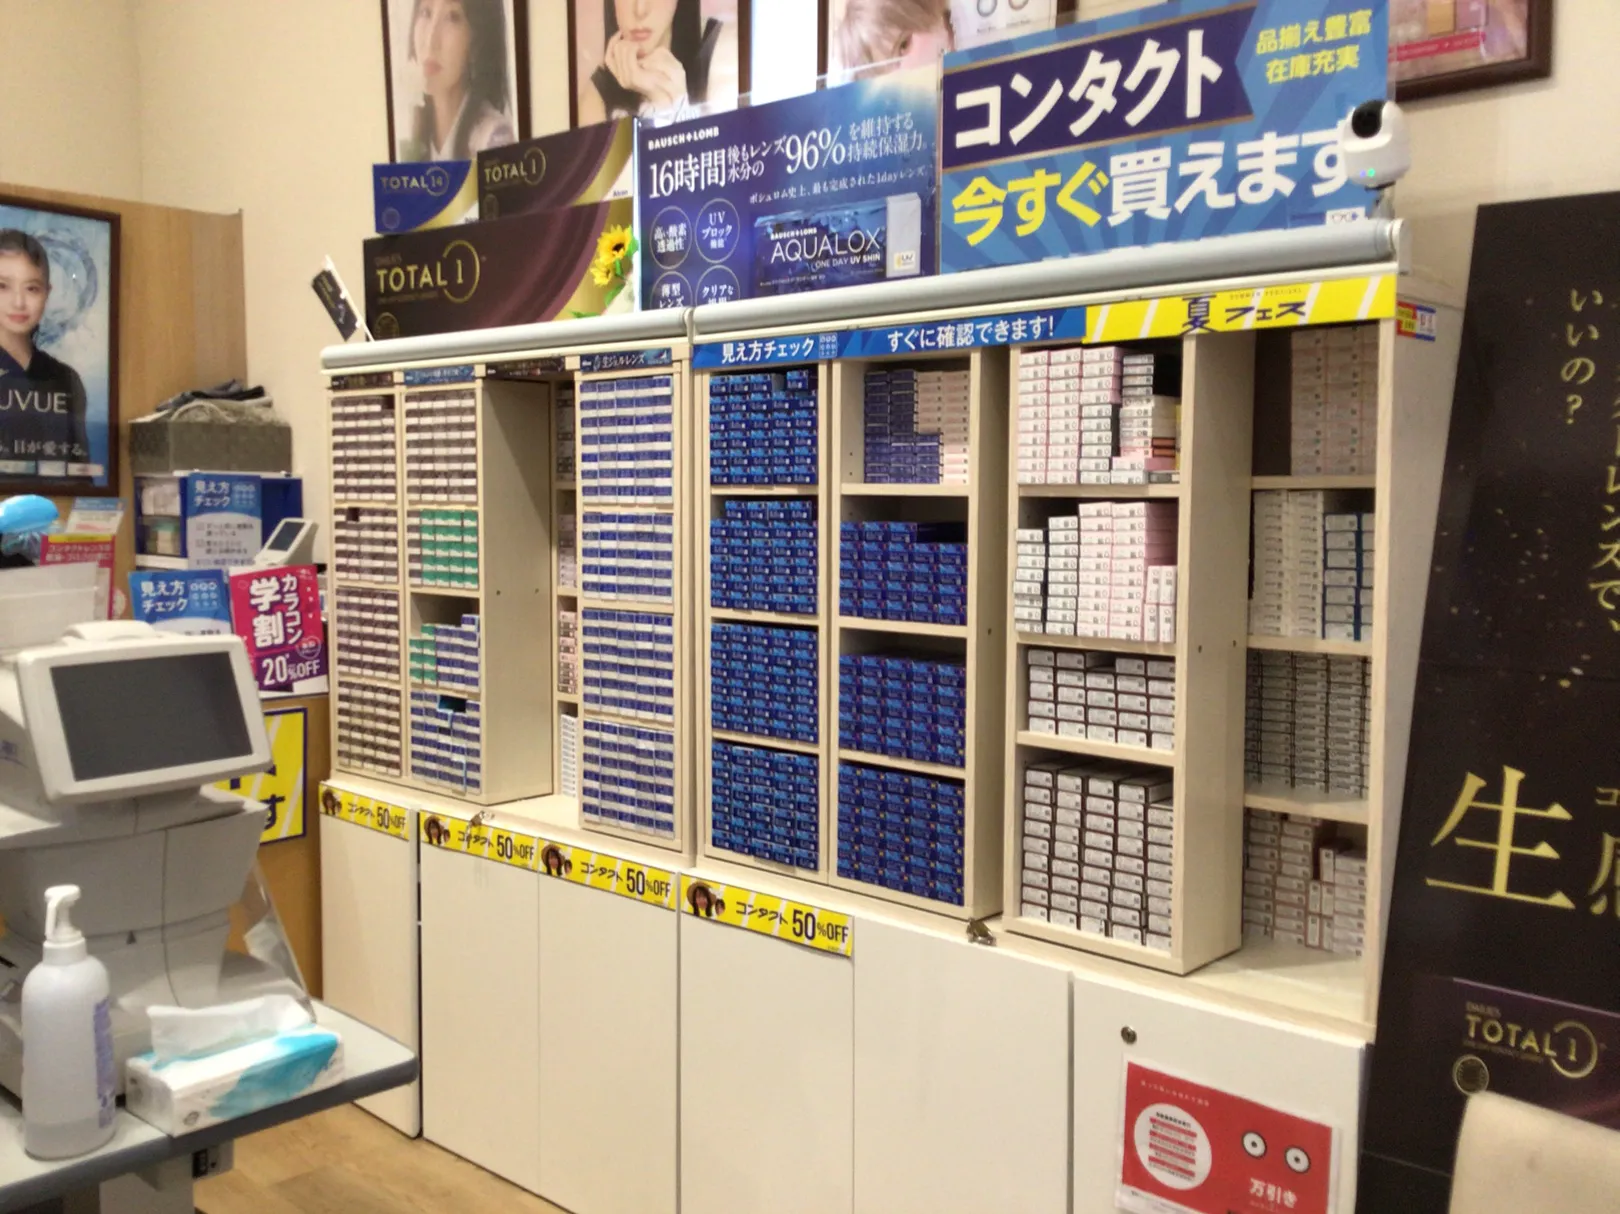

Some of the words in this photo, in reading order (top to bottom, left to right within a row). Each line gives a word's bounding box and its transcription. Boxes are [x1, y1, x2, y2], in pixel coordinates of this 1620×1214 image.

[1255, 9, 1373, 54] 品揃え豊富
[1265, 44, 1359, 85] 在庫充実
[954, 29, 1223, 149] コンタクト
[483, 160, 527, 183] TOTAL
[649, 148, 727, 199] 16時間
[785, 126, 847, 175] 96%
[727, 160, 765, 184] 水分の
[381, 175, 428, 191] TOTAL
[702, 224, 732, 240] ブロック
[709, 211, 725, 226] UV
[771, 228, 881, 264] AQUALOX
[376, 260, 448, 293] TOTAL
[721, 335, 815, 365] 見え方チェック
[140, 580, 186, 597] 見え方
[142, 597, 188, 613] チェック
[249, 576, 286, 649] 学割
[281, 573, 303, 644] カラコン
[580, 861, 623, 882] コンタクト
[626, 868, 671, 898] 50%OFF
[736, 901, 788, 925] コンタクト
[792, 908, 849, 944] 50%OFF
[1465, 1014, 1557, 1057] TOTAL
